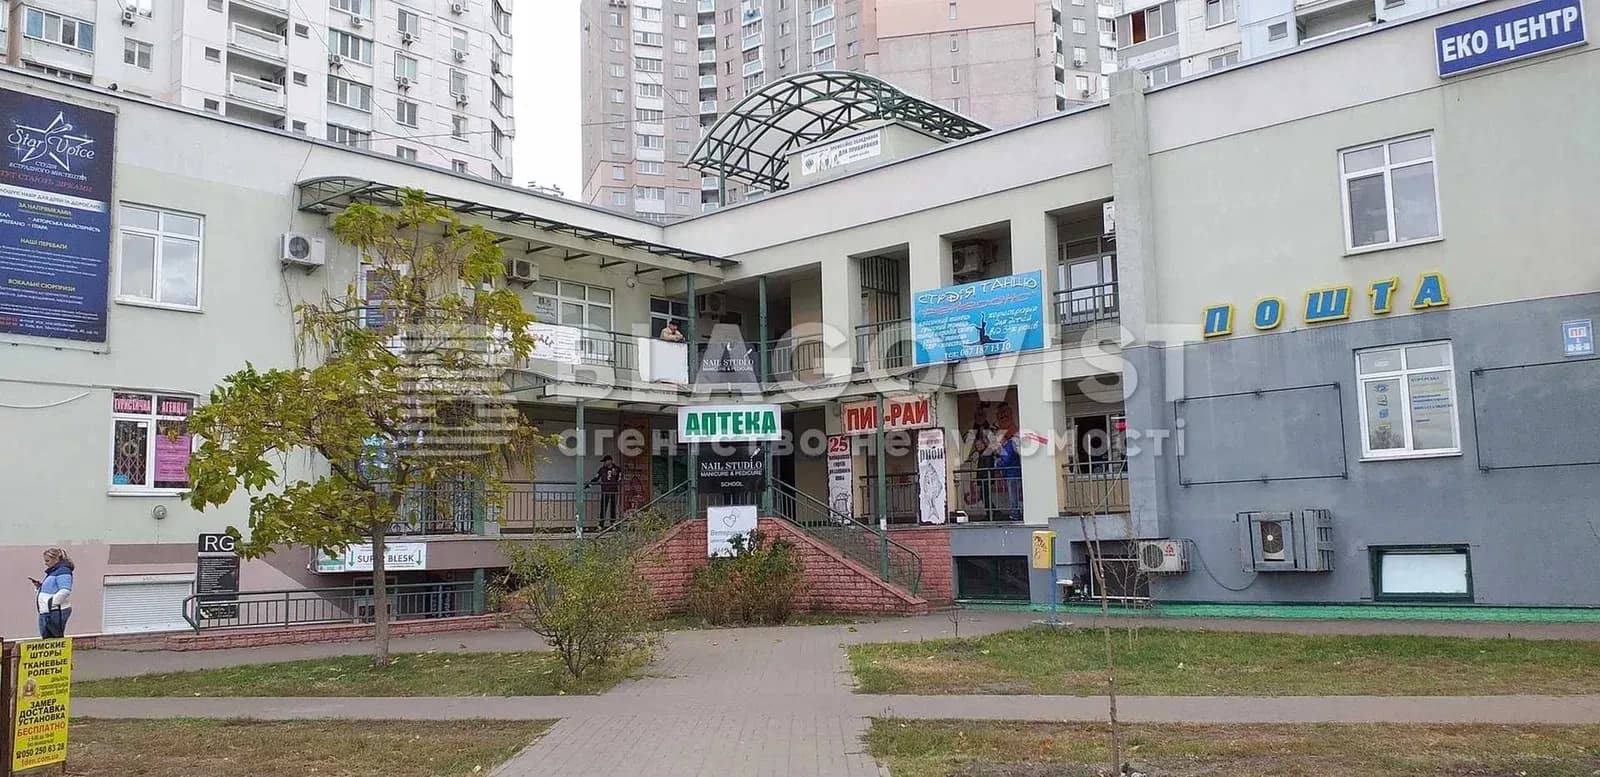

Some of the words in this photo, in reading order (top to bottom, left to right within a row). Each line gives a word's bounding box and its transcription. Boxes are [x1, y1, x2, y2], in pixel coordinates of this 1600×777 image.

[1442, 30, 1488, 63] ЕКО
[1494, 6, 1578, 51] ЦЕНТР
[8, 128, 46, 149] Star
[47, 136, 95, 160] Voice
[1201, 271, 1450, 338] ПОШТА
[702, 358, 721, 366] NAIL
[685, 411, 777, 436] АПТЕКА
[830, 437, 848, 453] 25
[701, 461, 723, 470] NAIL
[205, 535, 235, 552] RG
[388, 554, 415, 563] BLESK
[26, 640, 67, 651] РИМСКИЕ
[30, 649, 62, 659] ШТОРЫ
[23, 658, 68, 670] ТКАНЕВЫЕ
[27, 667, 62, 677] РОЛЕТЫ
[30, 698, 57, 709] ЗАМЕР
[18, 704, 66, 719] ДОСТАВКА
[18, 712, 66, 727] УСТАНОВКА
[17, 721, 66, 738] БЕСПЛАТНО
[21, 749, 34, 759] 050
[35, 746, 47, 756] 250
[48, 744, 56, 753] 63
